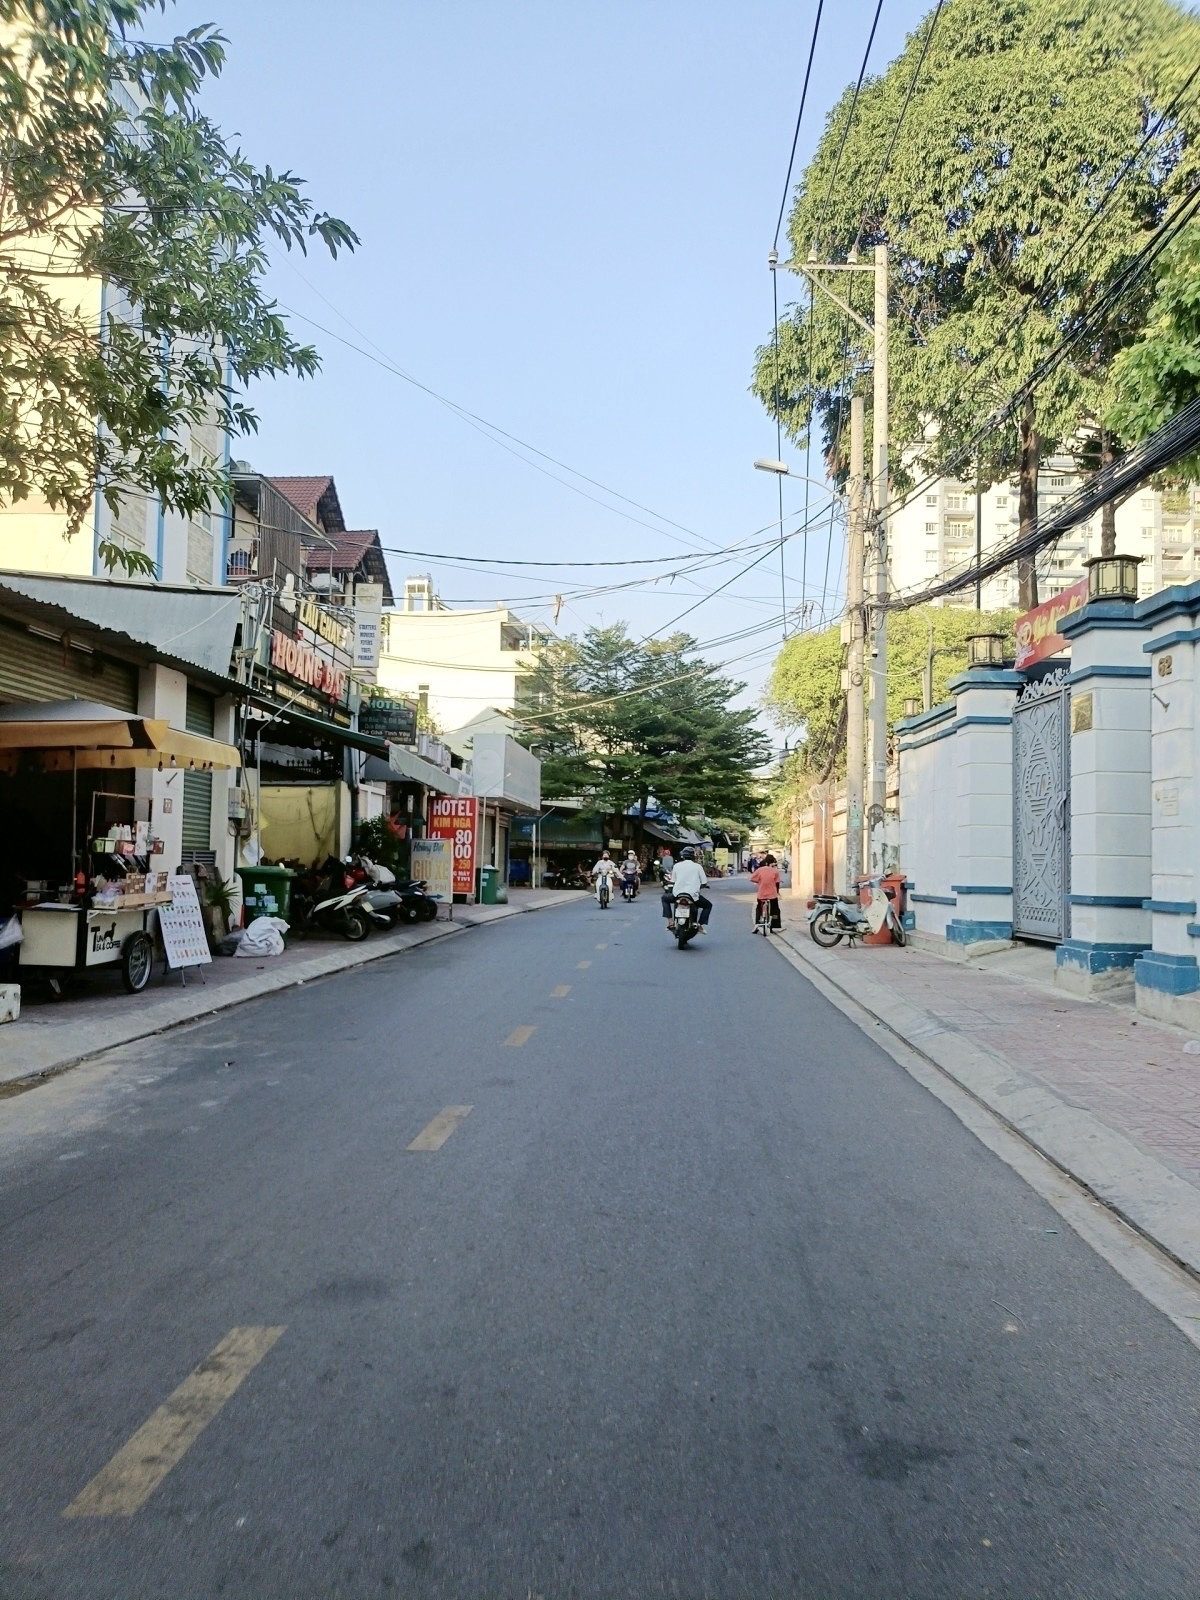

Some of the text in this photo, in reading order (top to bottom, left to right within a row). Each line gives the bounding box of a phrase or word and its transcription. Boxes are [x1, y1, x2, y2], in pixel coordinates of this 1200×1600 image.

[1158, 655, 1172, 677] 62
[368, 699, 408, 710] HOTEL
[433, 799, 473, 816] HOTEL
[433, 817, 471, 829] KIM NGA
[455, 829, 473, 845] 80
[453, 844, 472, 860] 00
